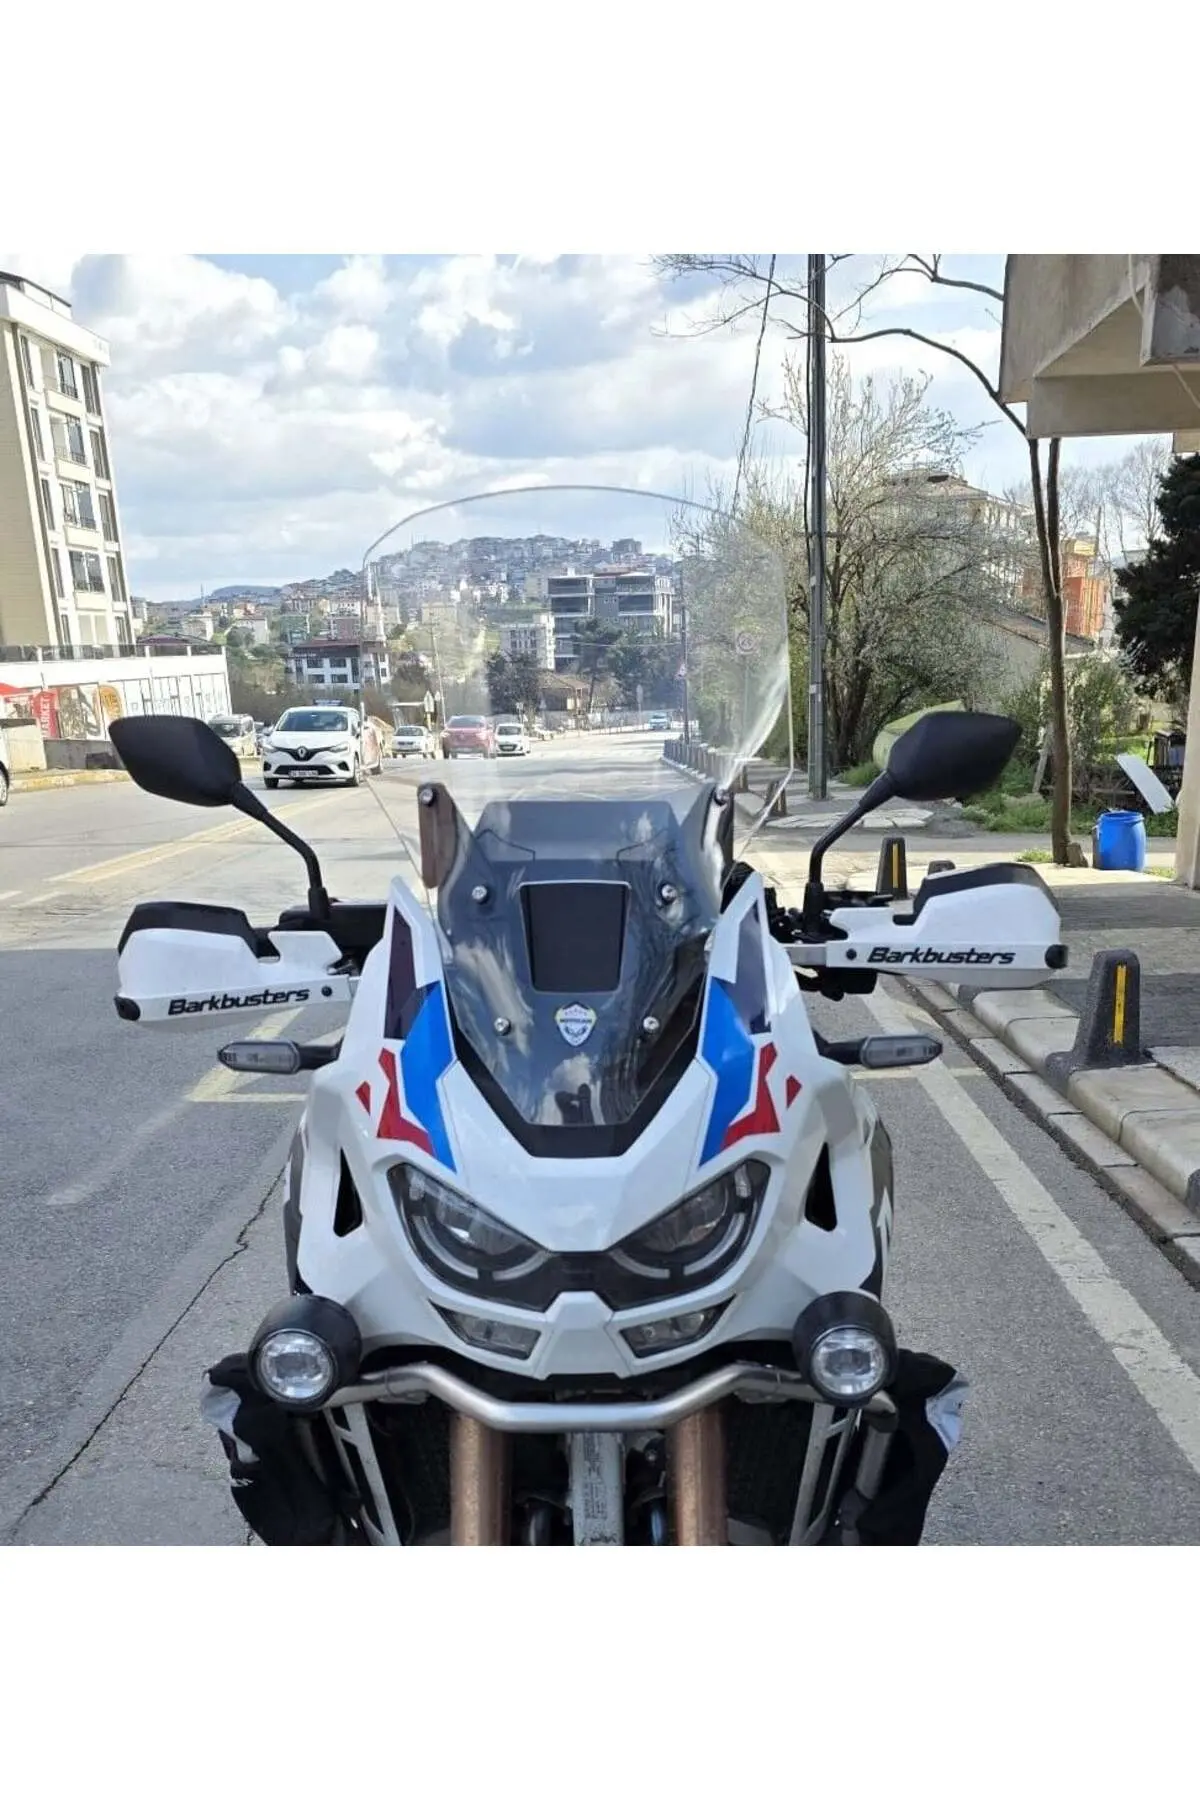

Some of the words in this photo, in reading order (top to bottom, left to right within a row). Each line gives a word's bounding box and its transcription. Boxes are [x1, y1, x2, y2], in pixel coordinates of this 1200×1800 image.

[40, 696, 50, 737] MARKET
[867, 947, 1016, 964] Barkbusters
[168, 988, 310, 1015] Barkbusters
